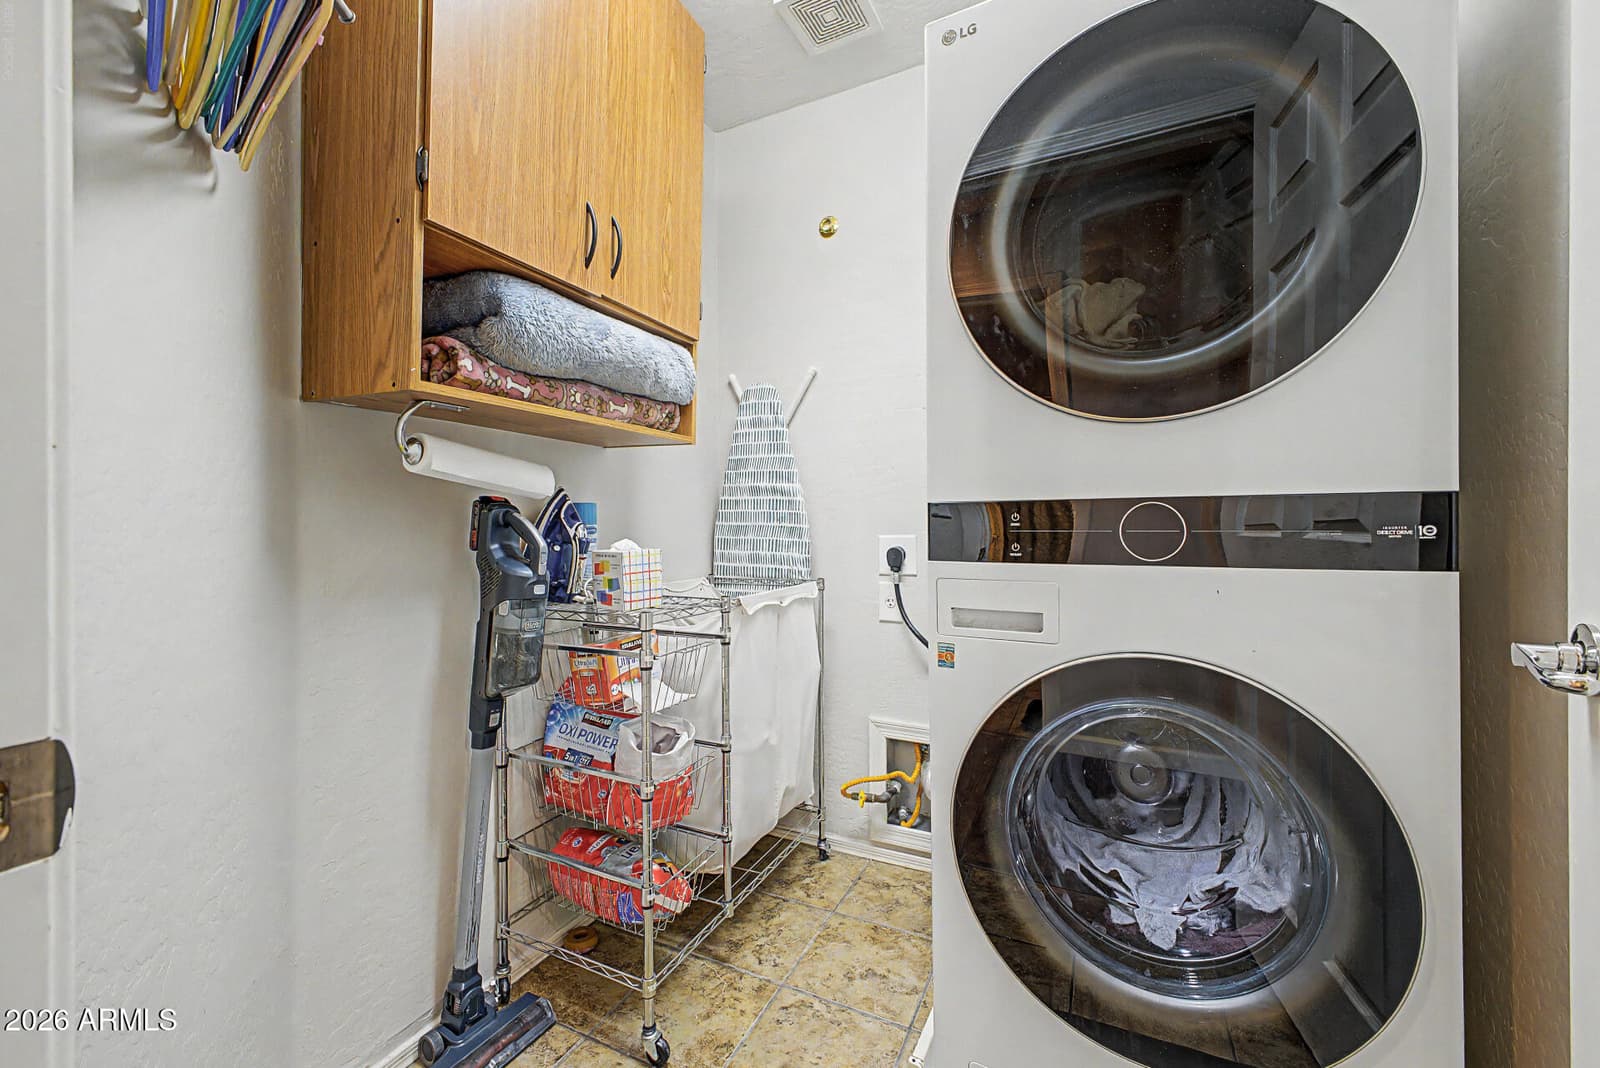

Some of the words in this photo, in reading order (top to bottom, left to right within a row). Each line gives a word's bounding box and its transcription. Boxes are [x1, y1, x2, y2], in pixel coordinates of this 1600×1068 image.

[960, 23, 977, 38] LG
[559, 723, 578, 737] OXI
[577, 728, 619, 749] POWER
